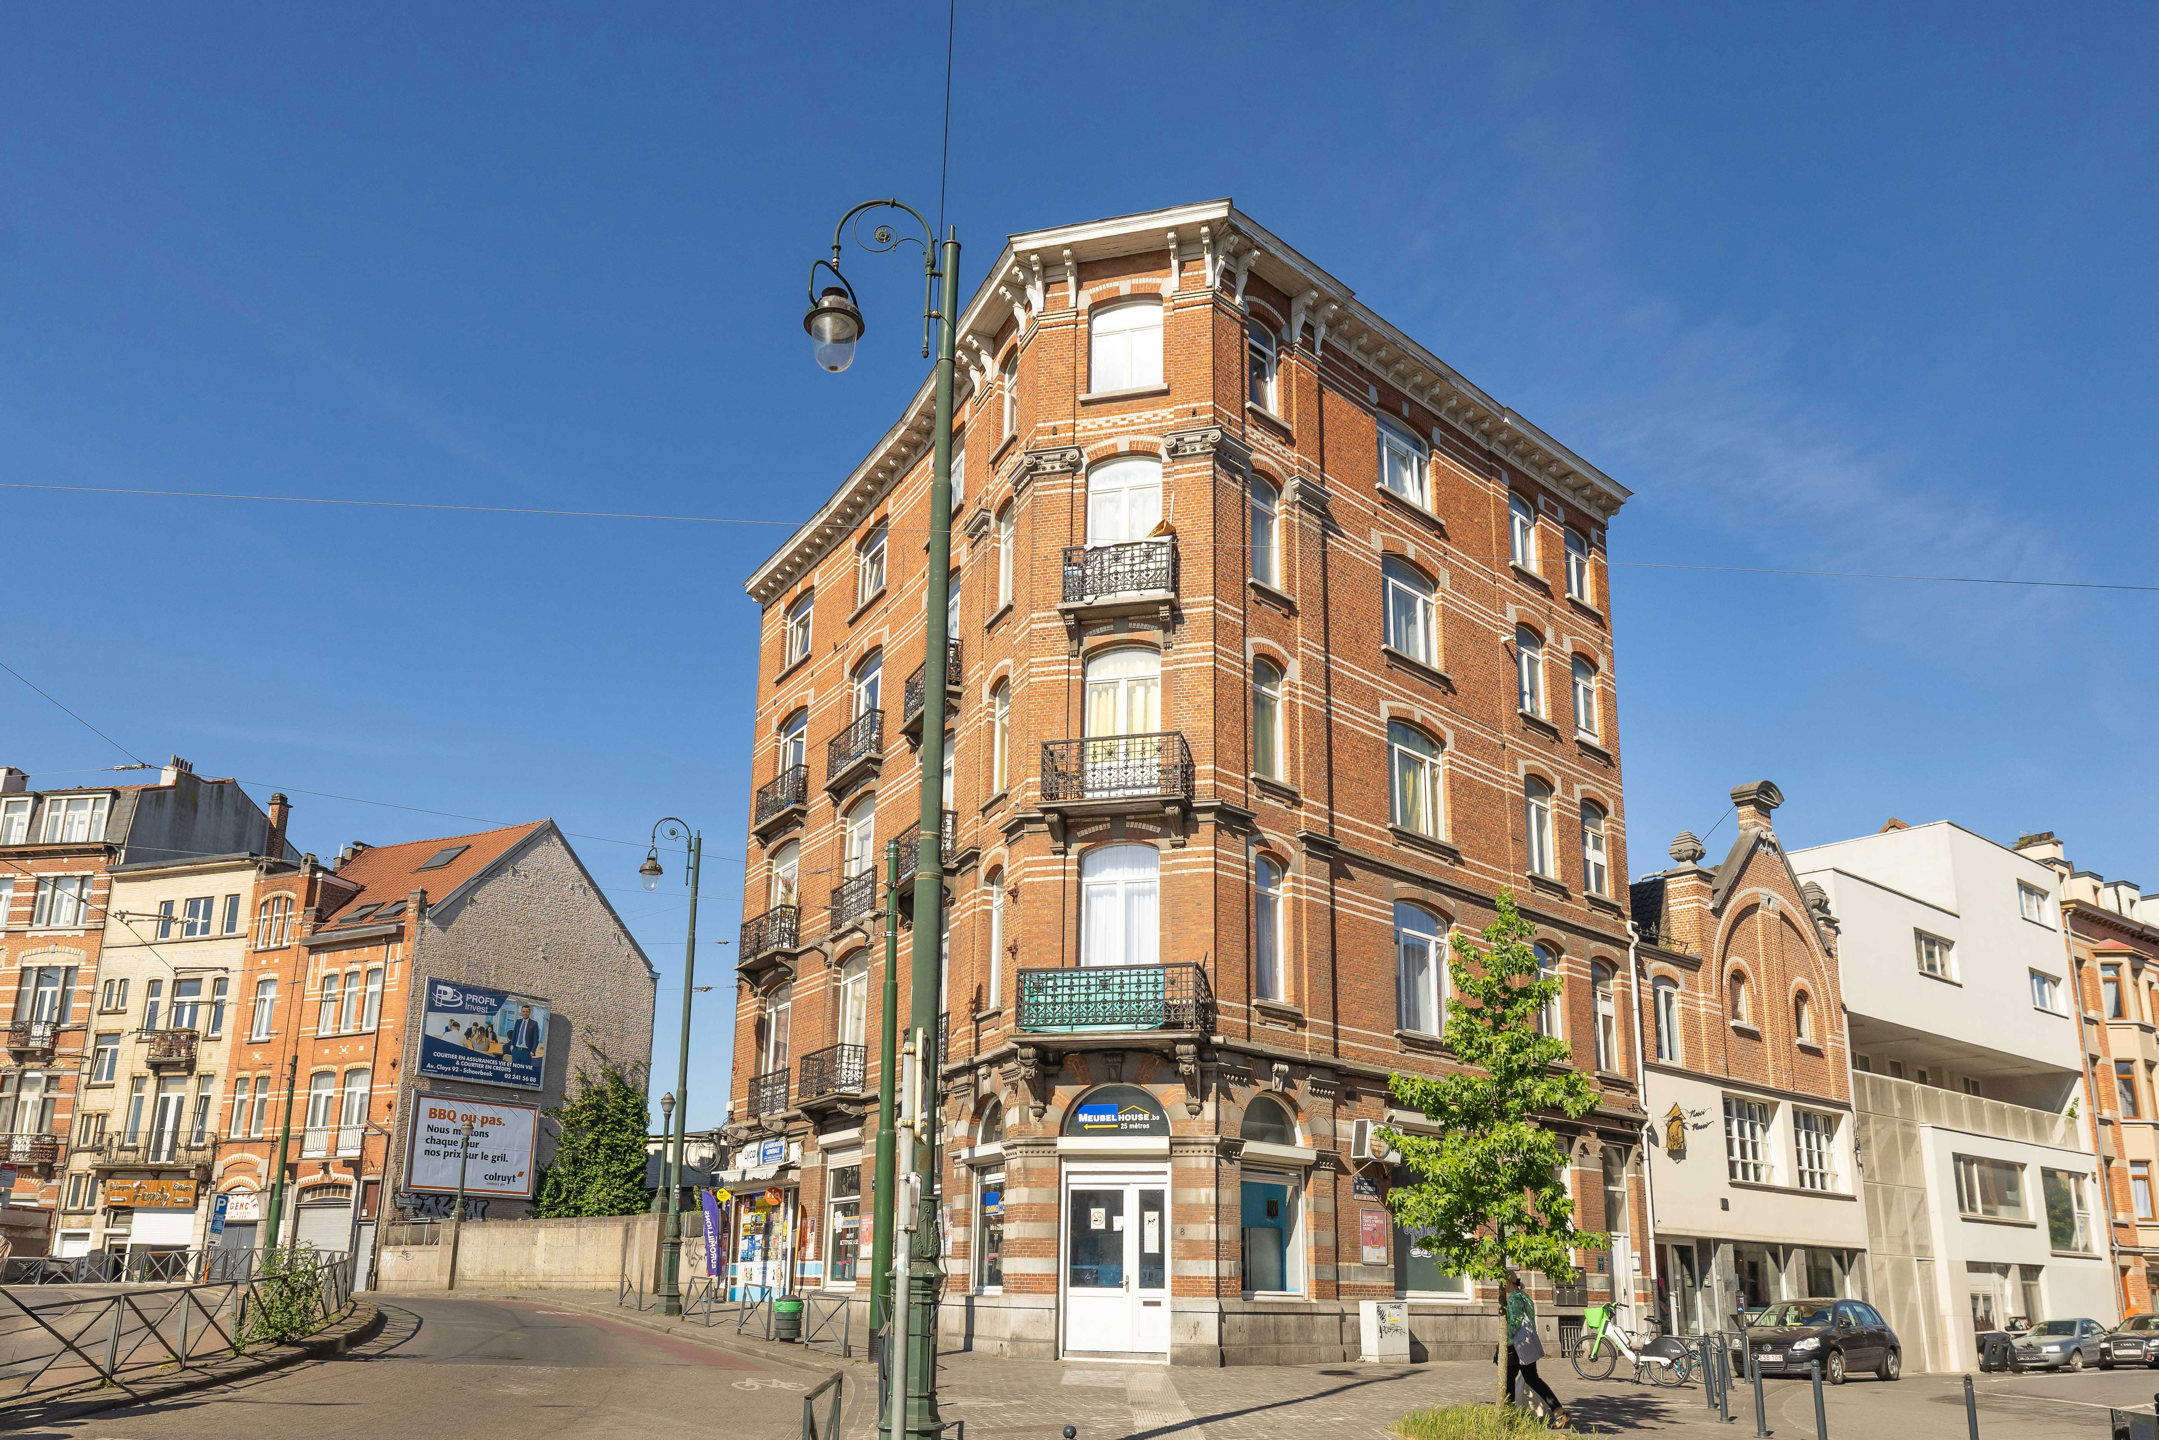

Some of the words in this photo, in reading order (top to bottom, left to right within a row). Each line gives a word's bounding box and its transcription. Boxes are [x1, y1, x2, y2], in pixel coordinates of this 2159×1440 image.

[466, 994, 498, 1007] PROFIL
[464, 1002, 488, 1013] Invest
[433, 1052, 458, 1060] COURTIER
[466, 1056, 498, 1066] ASSURANCES
[460, 1062, 484, 1070] COURTIER
[428, 1107, 456, 1124] BBQ
[460, 1113, 477, 1124] ou
[480, 1115, 506, 1128] pas.
[426, 1124, 450, 1134] Nous
[425, 1136, 458, 1148] chaque
[443, 1149, 461, 1160] prix
[481, 1152, 488, 1160] le
[491, 1153, 508, 1163] gril.
[484, 1172, 516, 1184] colruyt
[216, 1198, 226, 1211] P
